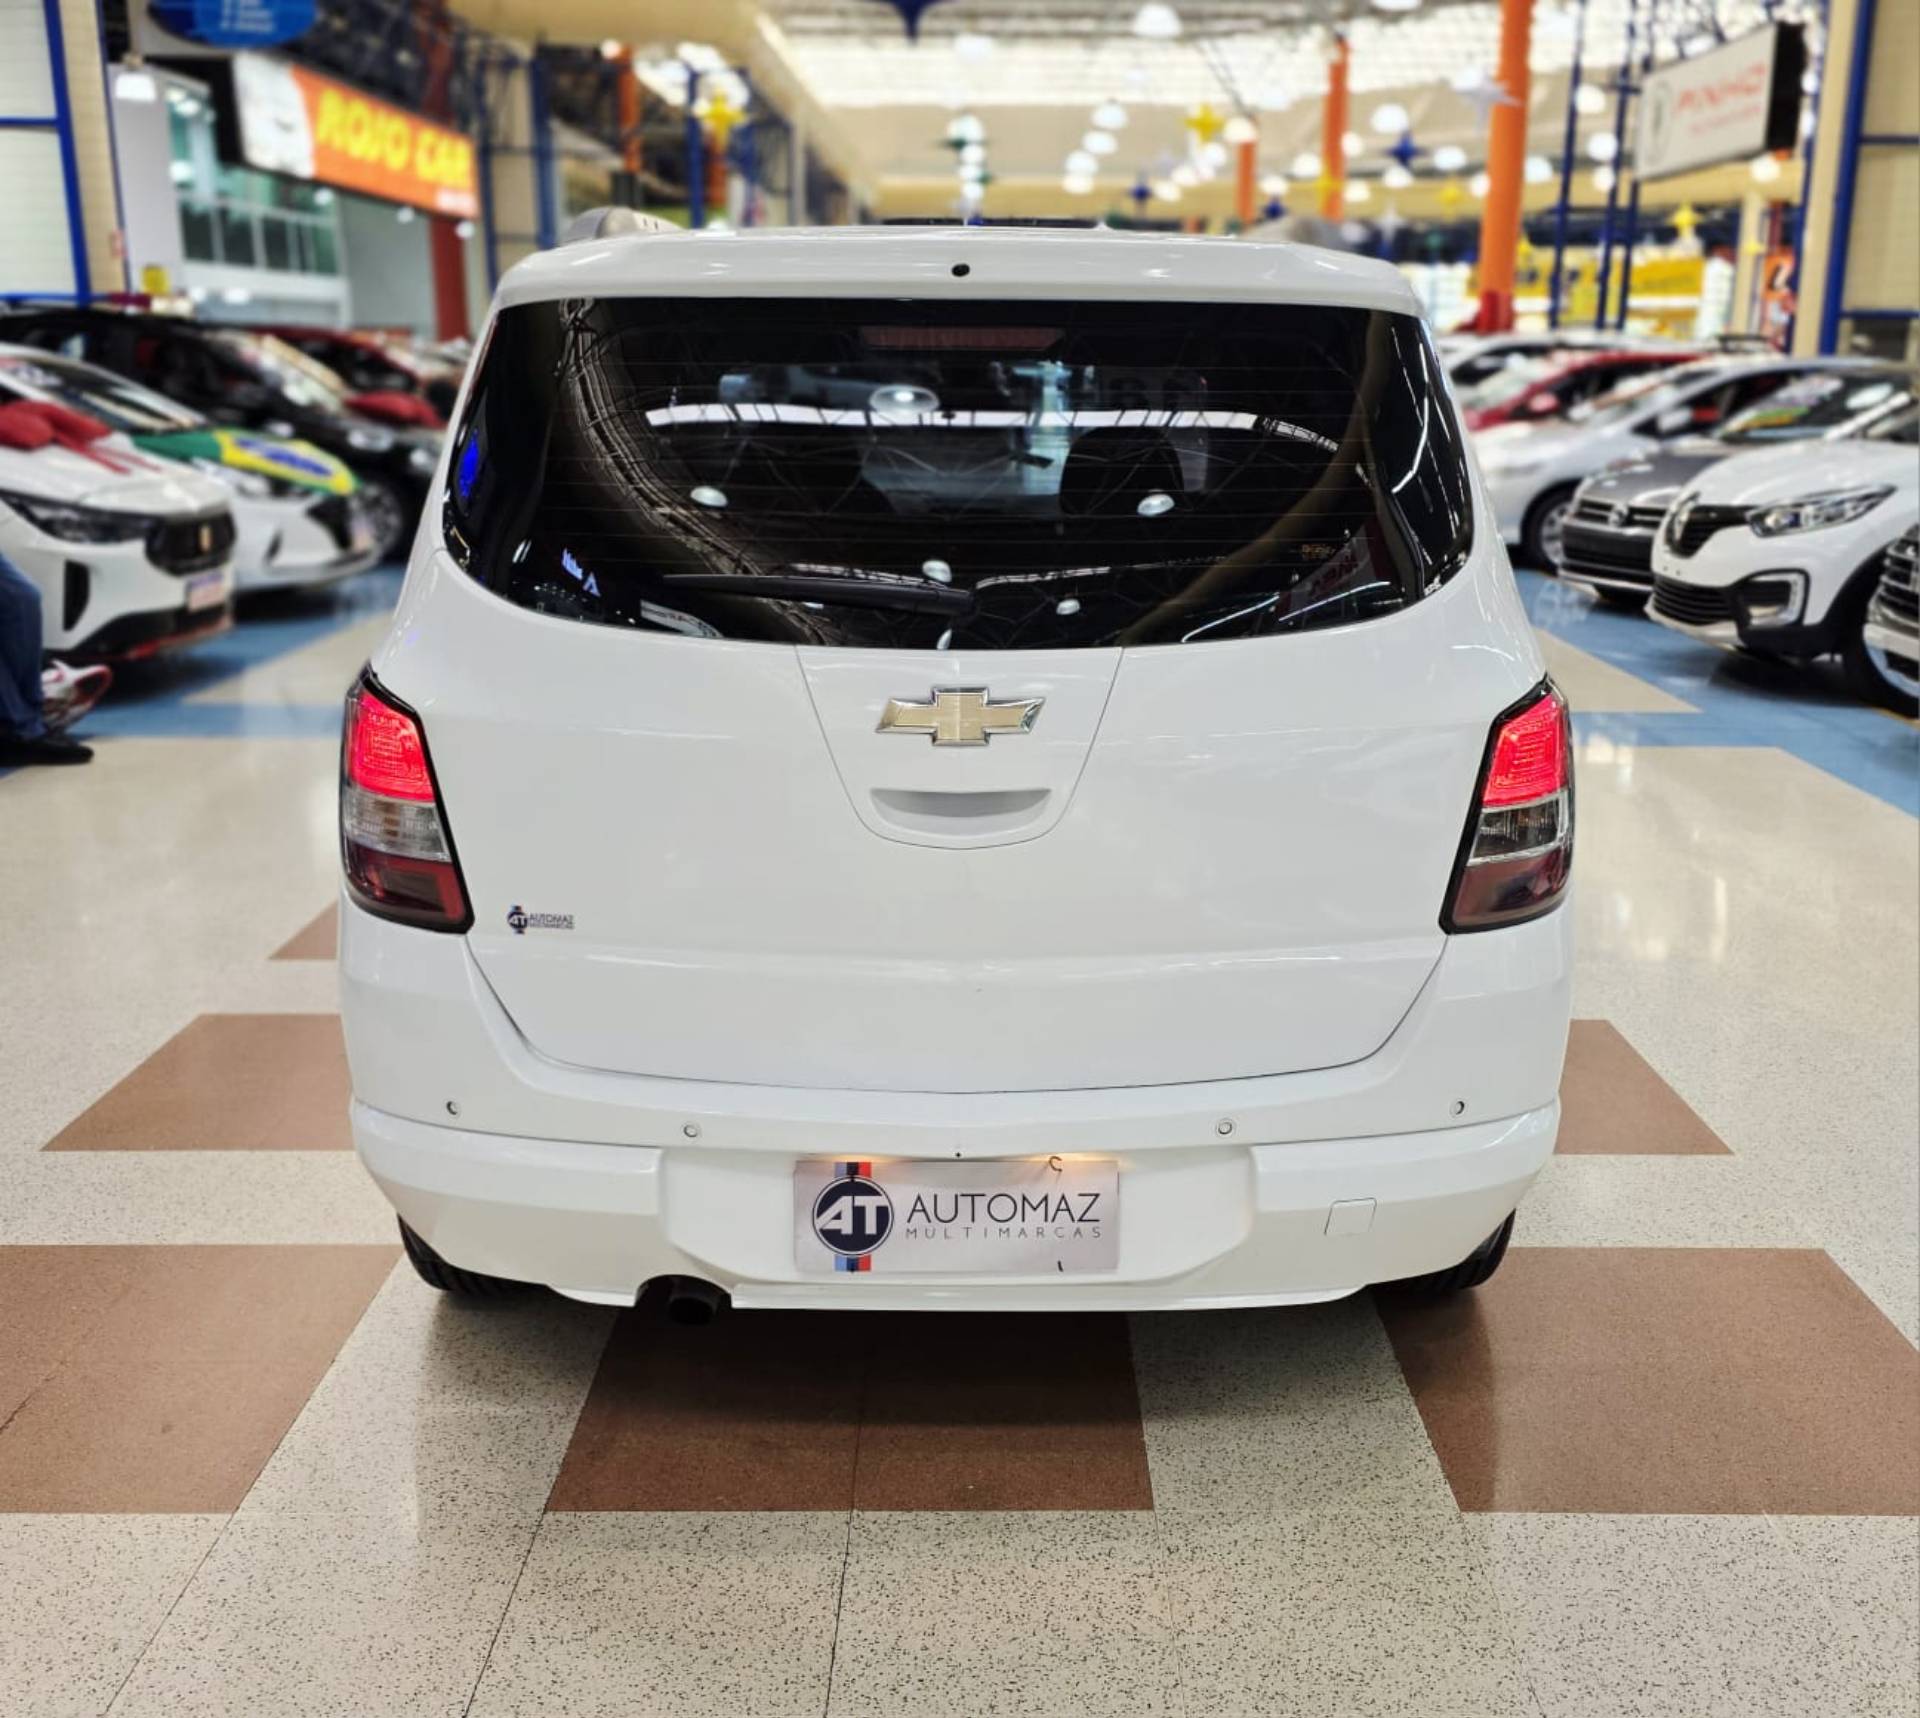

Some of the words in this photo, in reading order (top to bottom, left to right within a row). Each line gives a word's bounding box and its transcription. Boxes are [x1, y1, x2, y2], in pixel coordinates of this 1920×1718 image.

[816, 1195, 887, 1235] AT
[907, 1193, 1101, 1223] AUTOMAZ
[905, 1226, 1102, 1239] MULTIMARCAS
